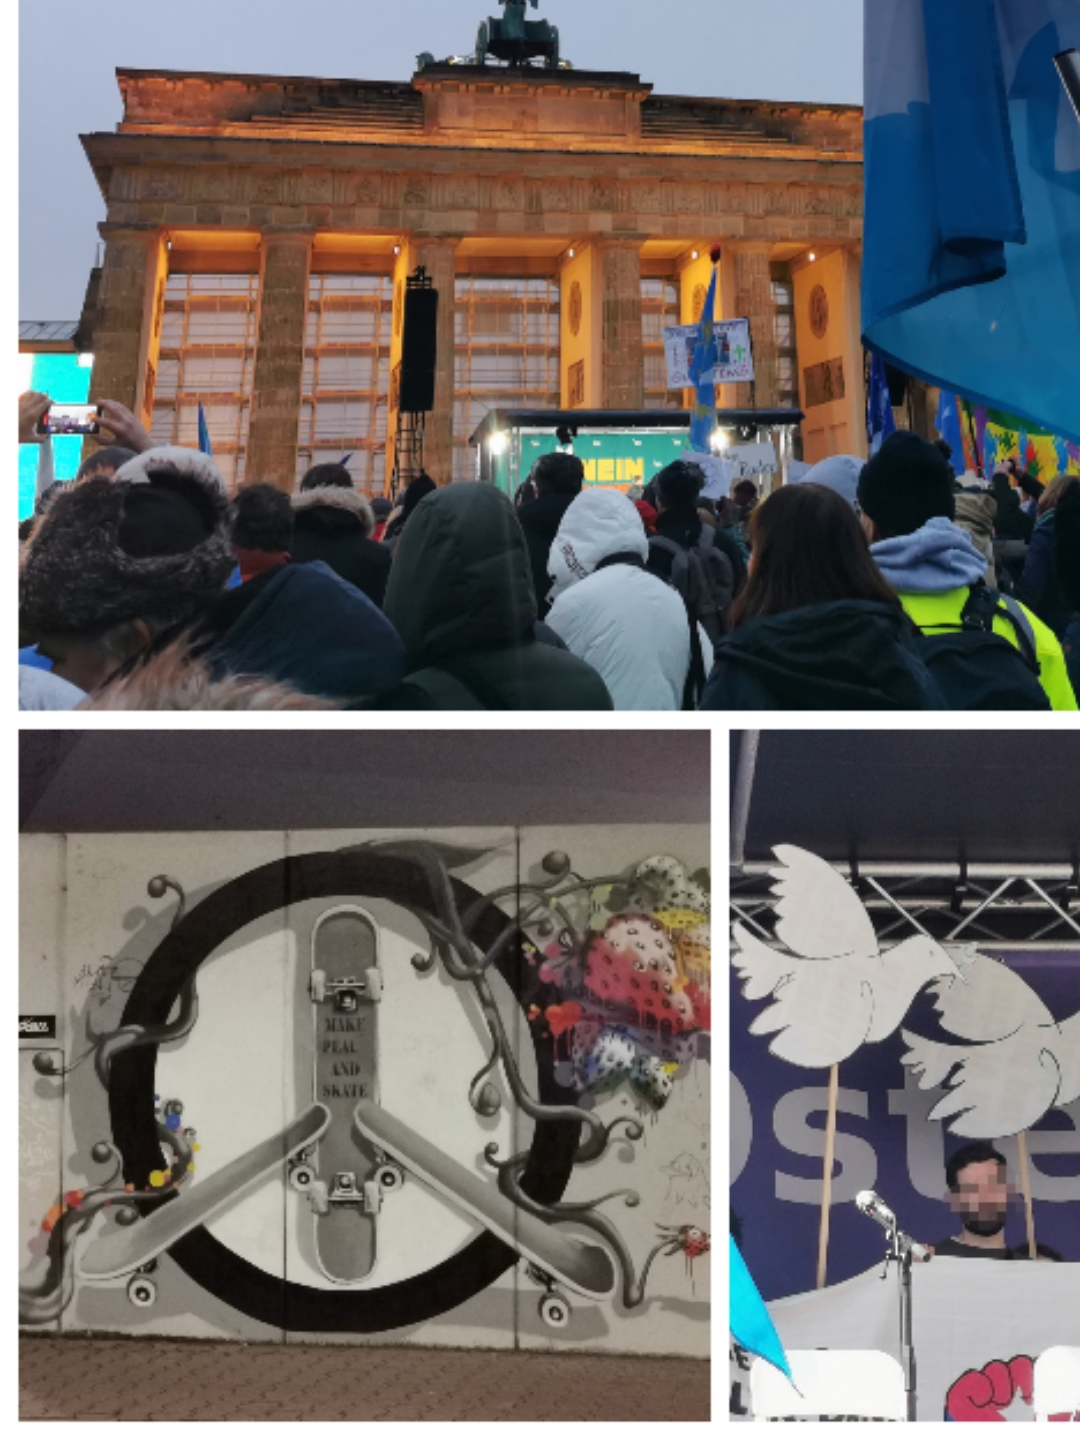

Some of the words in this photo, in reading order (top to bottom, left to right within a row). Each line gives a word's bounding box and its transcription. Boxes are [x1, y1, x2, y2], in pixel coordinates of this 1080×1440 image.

[325, 1017, 366, 1033] MAKE
[332, 1061, 361, 1076] AND
[322, 1083, 369, 1099] SKATE
